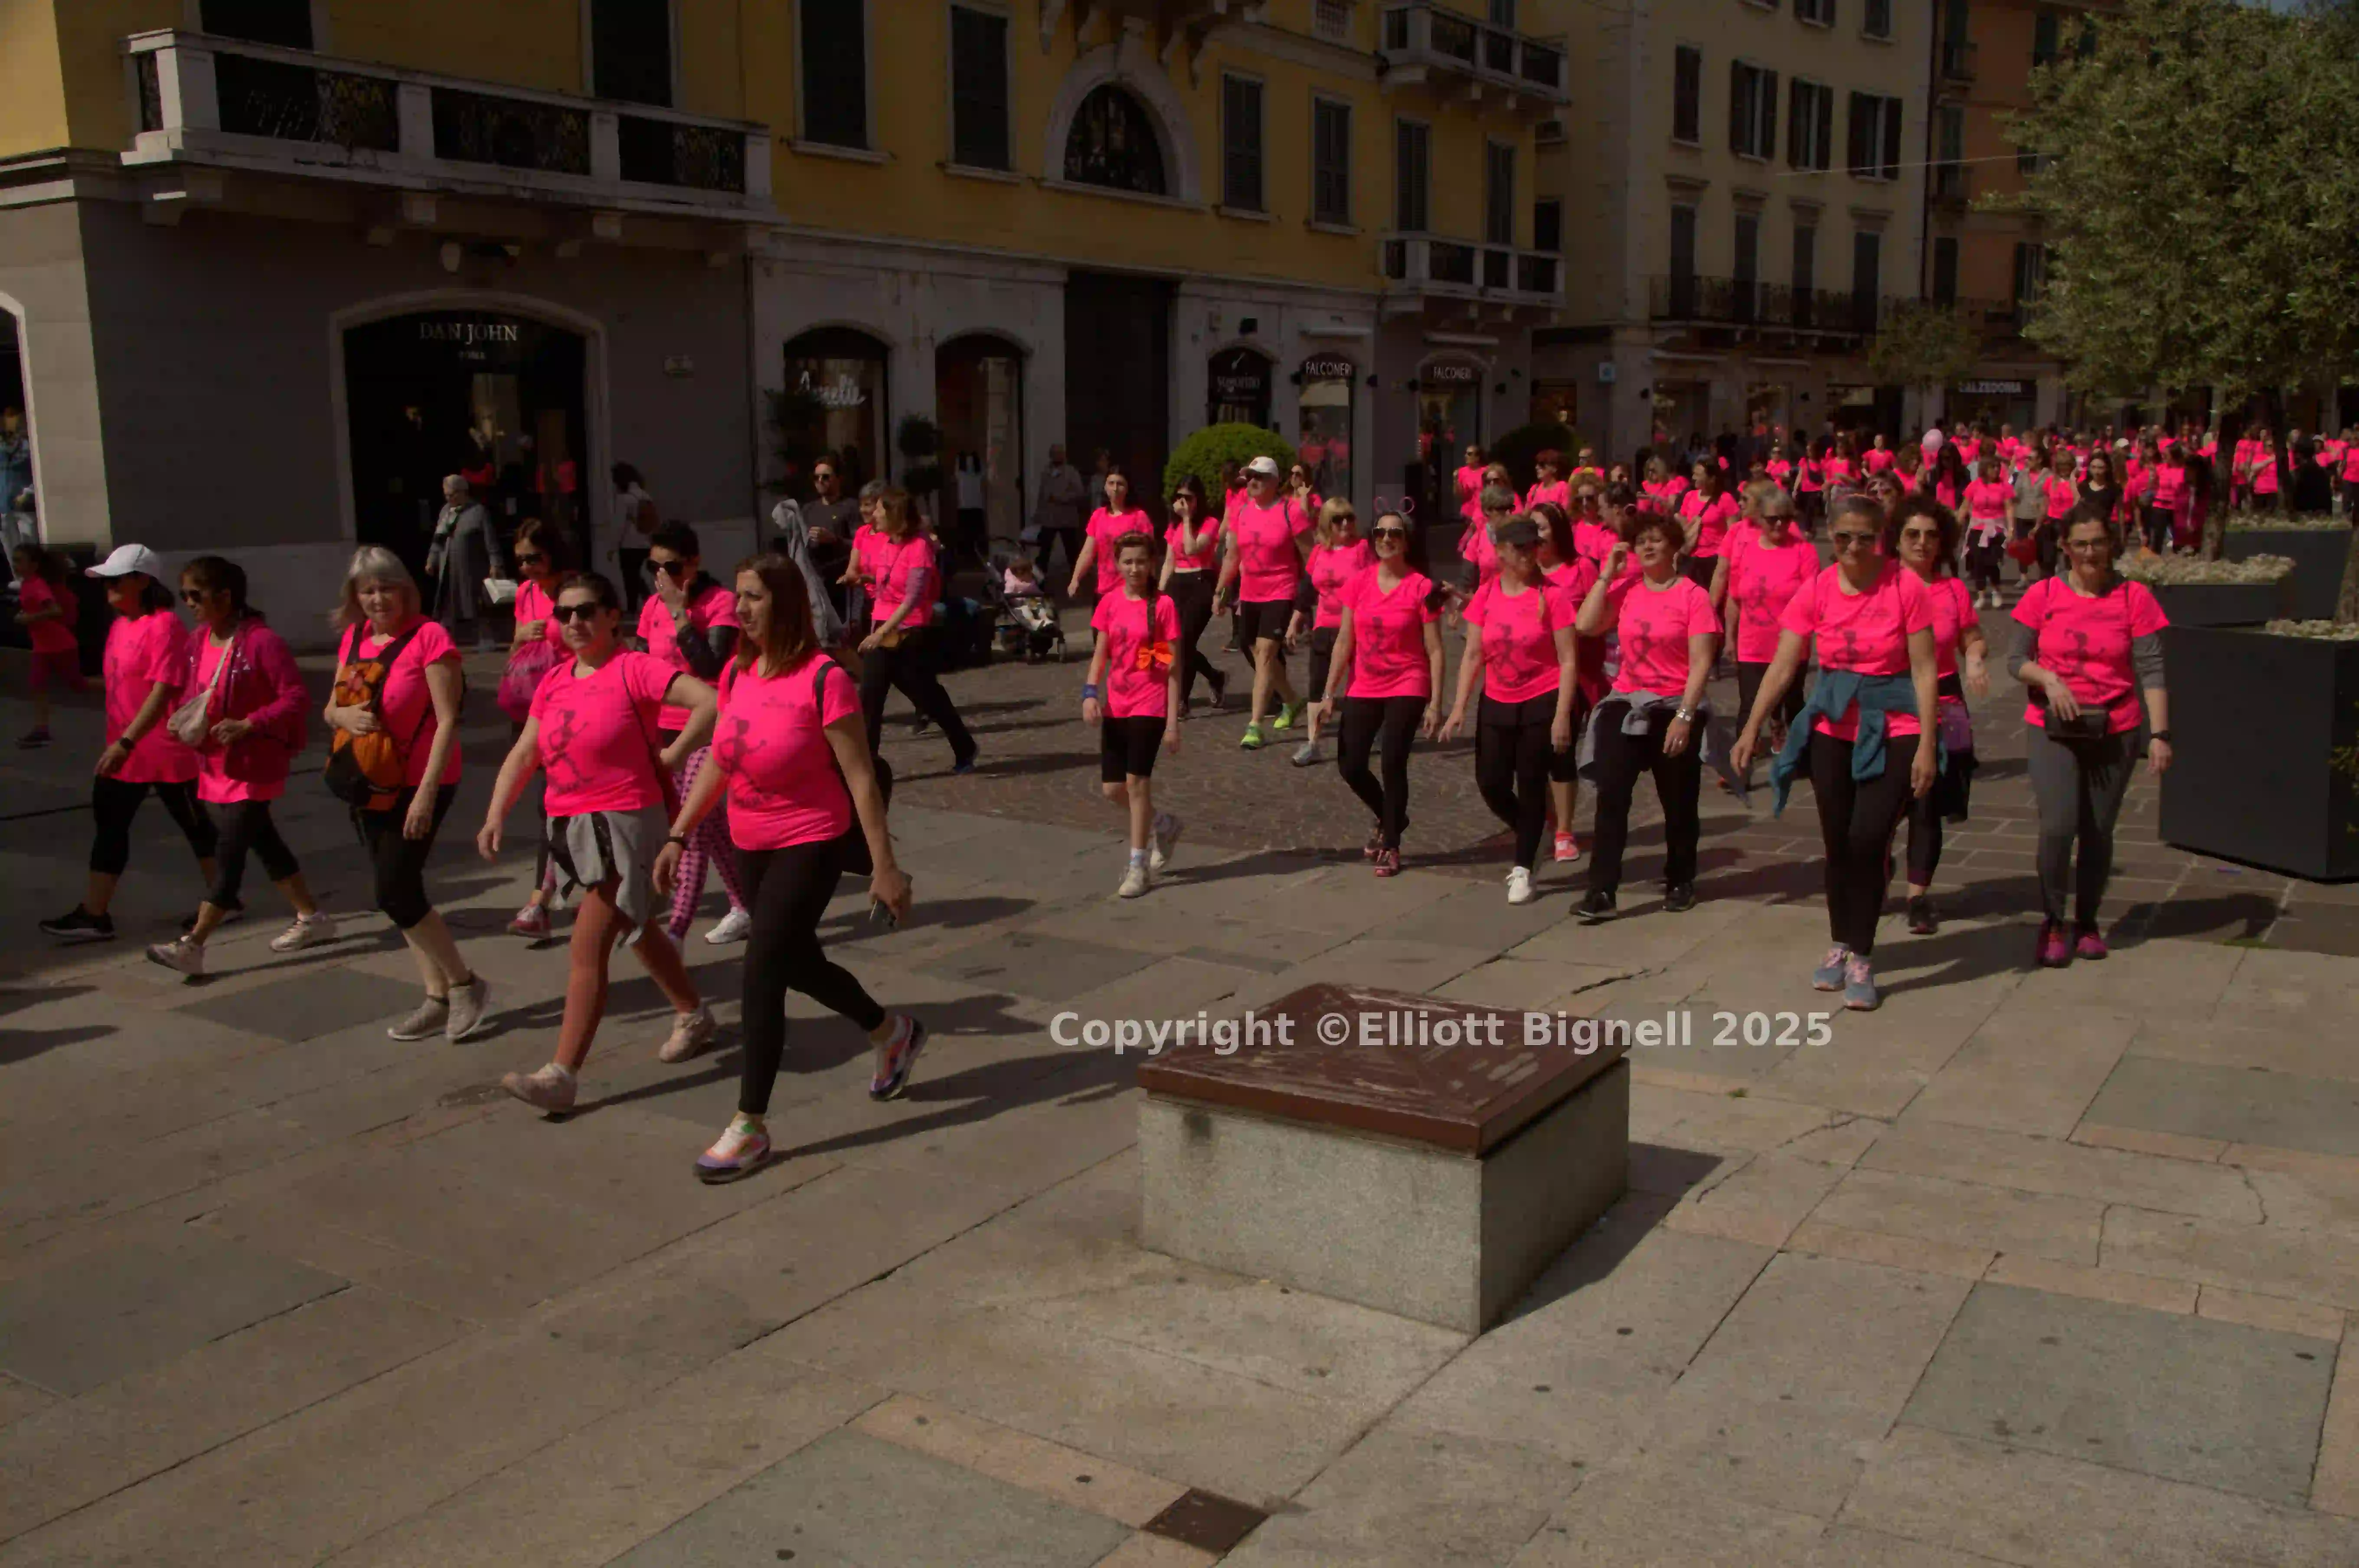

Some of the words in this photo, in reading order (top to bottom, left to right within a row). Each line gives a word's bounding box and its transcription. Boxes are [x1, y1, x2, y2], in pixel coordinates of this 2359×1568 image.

[419, 322, 461, 341] DAN
[464, 323, 517, 345] JOHN
[1306, 361, 1352, 376] FALCONERI
